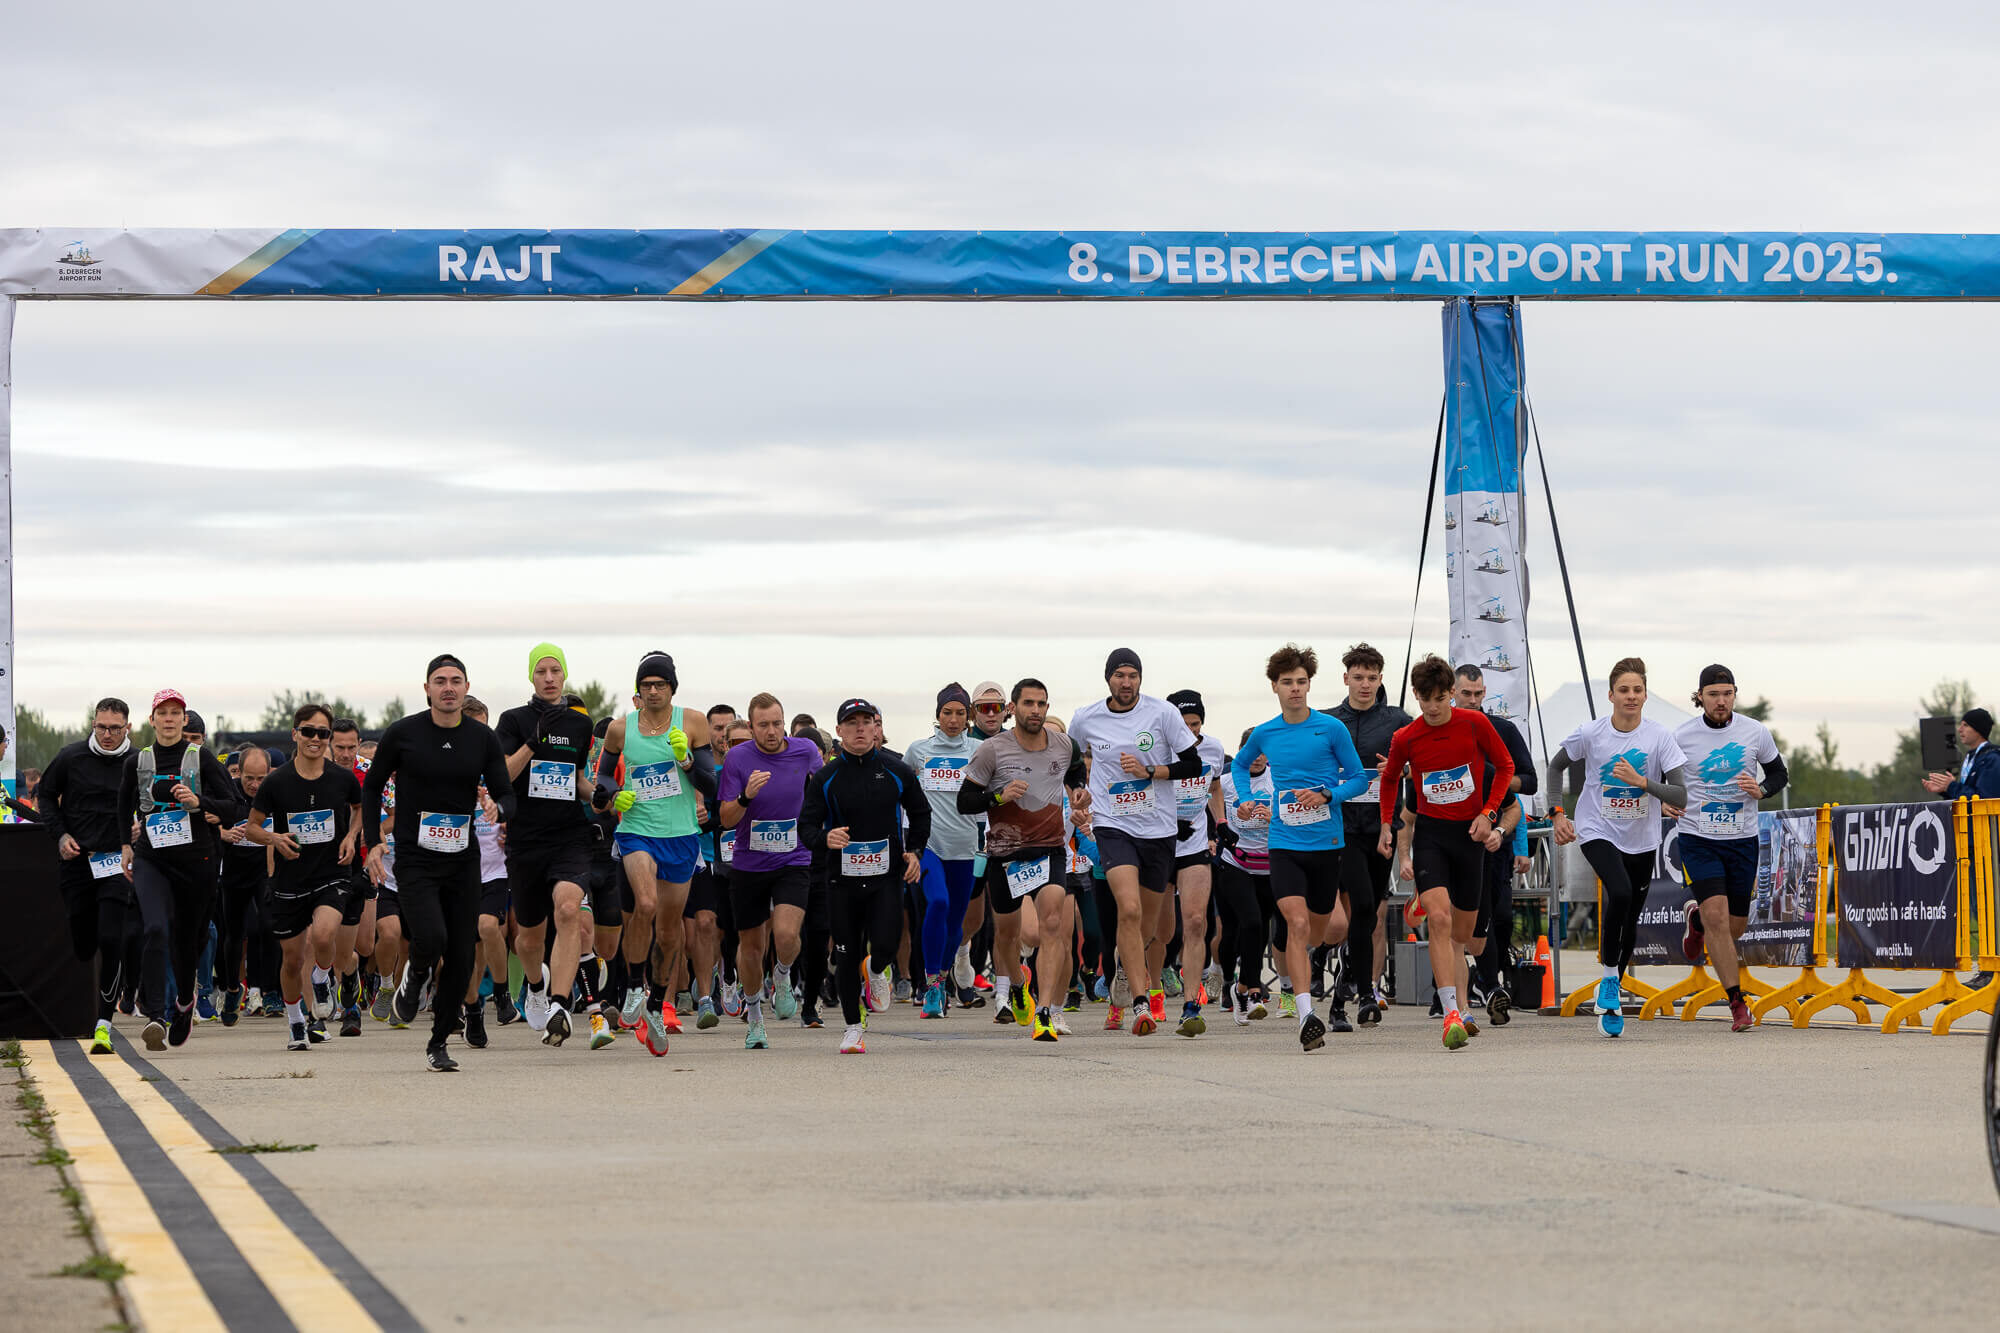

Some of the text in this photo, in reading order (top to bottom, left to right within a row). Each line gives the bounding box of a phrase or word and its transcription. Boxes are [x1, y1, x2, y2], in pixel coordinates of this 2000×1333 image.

[439, 245, 560, 282] RAJT
[1068, 242, 1898, 284] 8. DEBRECEN AIRPORT RUN 2025.
[548, 733, 570, 745] team
[539, 774, 570, 786] 1347
[930, 768, 961, 779] 5096
[638, 774, 671, 788] 1034
[1181, 776, 1206, 788] 5144
[1431, 779, 1464, 794] 5520
[1115, 791, 1147, 804] 5239
[1610, 798, 1641, 808] 5251
[1708, 813, 1736, 823] 1421
[152, 822, 182, 835] 1263
[296, 822, 326, 833] 1341
[428, 826, 461, 839] 5530
[759, 832, 789, 841] 1001
[98, 855, 122, 868] 106
[850, 853, 882, 864] 5245
[1013, 864, 1043, 883] 1384
[1643, 907, 1651, 924] in
[1651, 905, 1669, 924] safe
[1670, 905, 1686, 924] han
[1844, 903, 1865, 922] Your
[1866, 901, 1889, 928] goods
[1890, 901, 1898, 921] in
